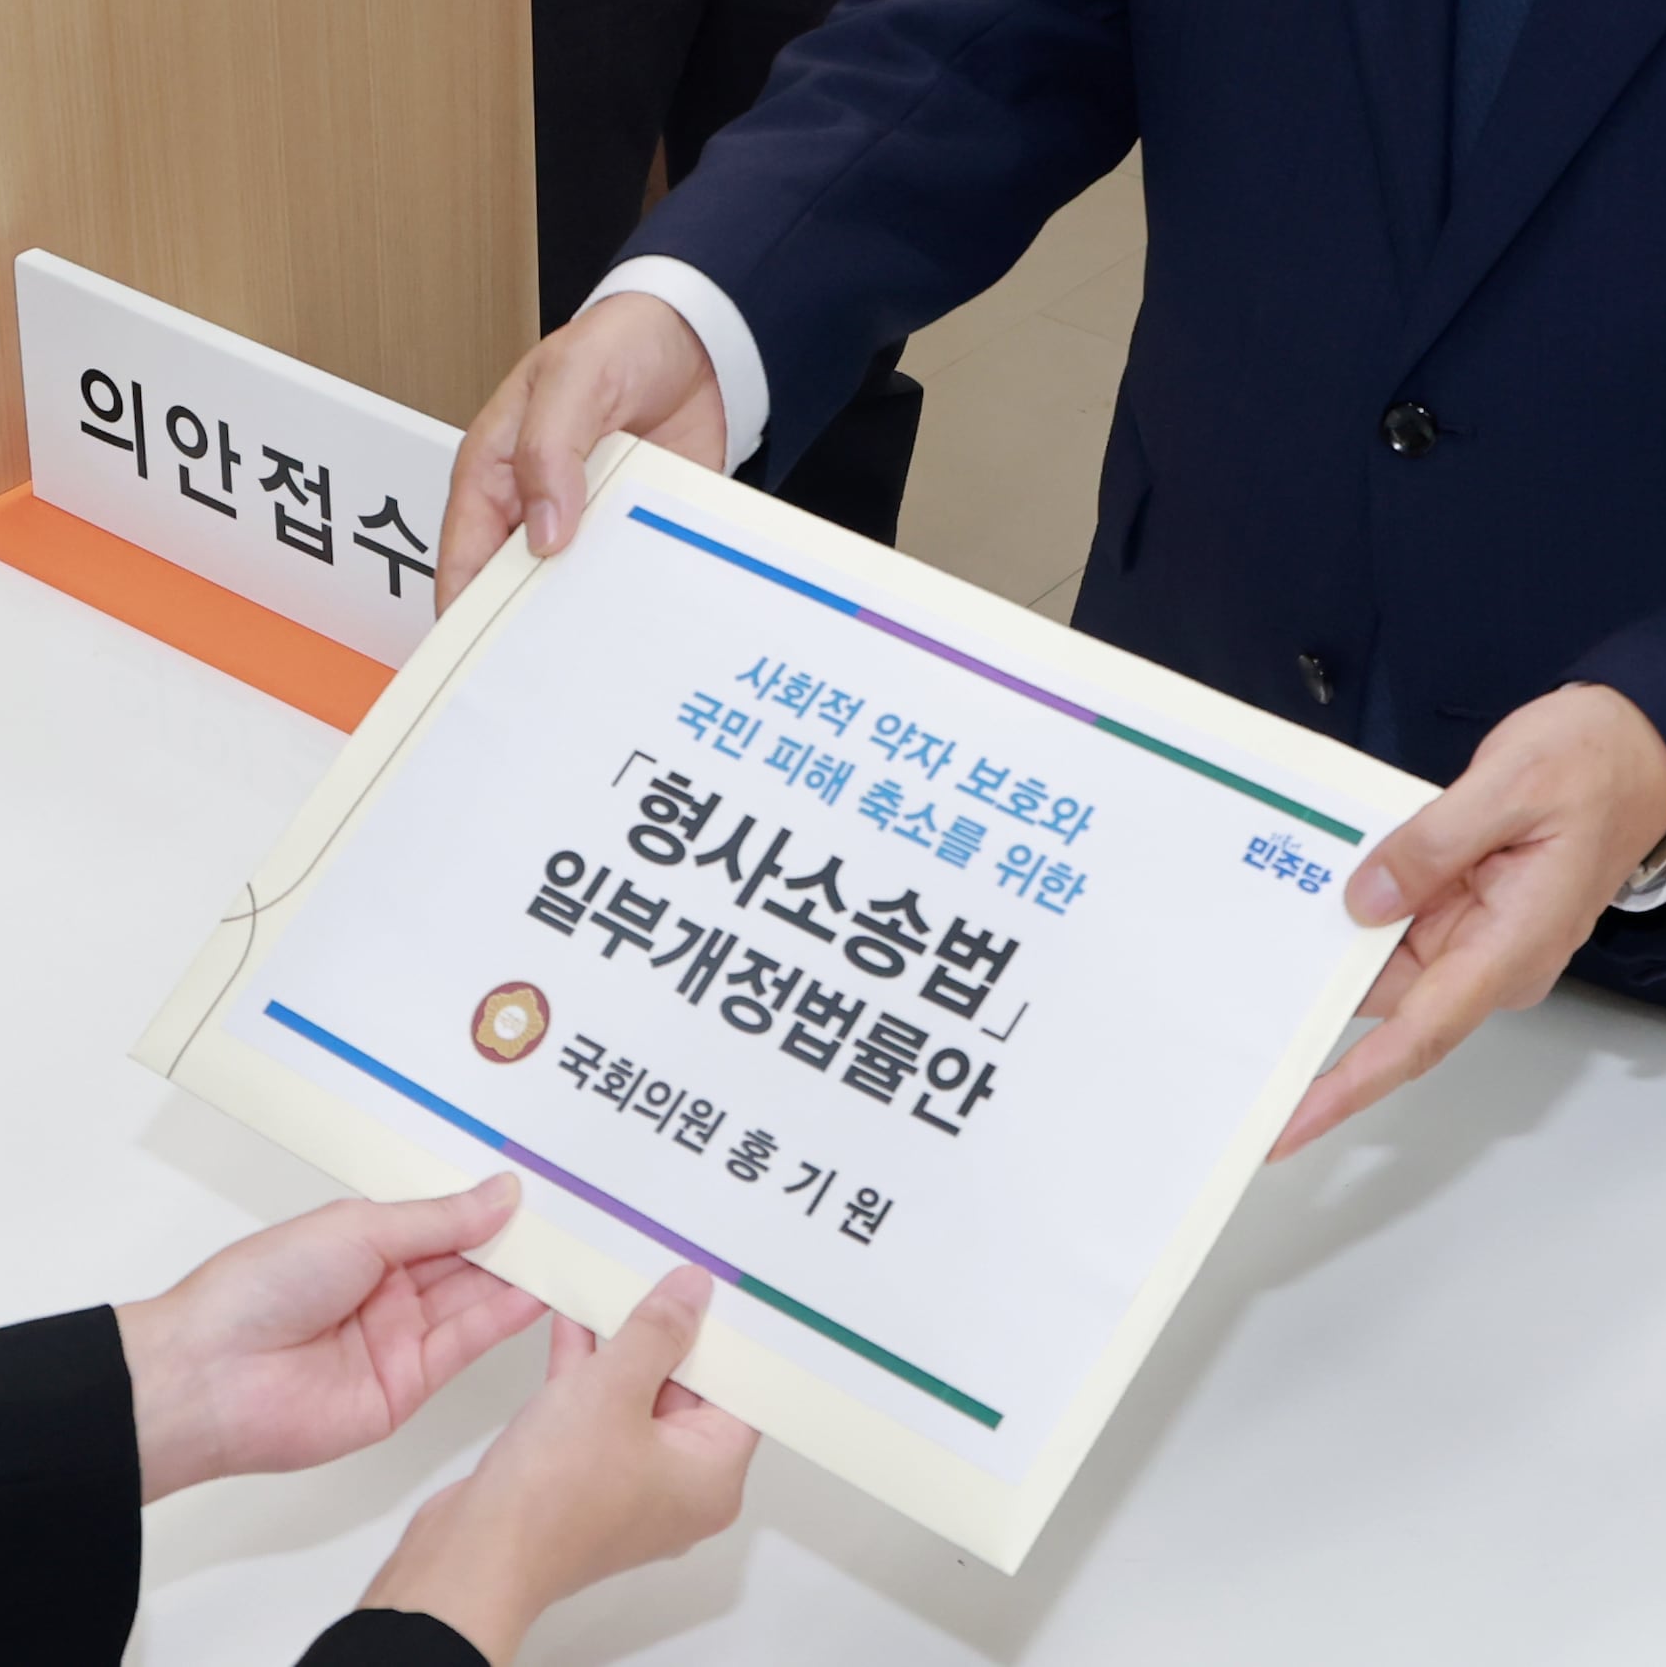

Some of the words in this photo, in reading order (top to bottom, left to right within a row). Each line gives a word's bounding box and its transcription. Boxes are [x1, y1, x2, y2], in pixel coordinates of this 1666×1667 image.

[80, 368, 436, 598] 의안접수
[677, 691, 763, 760] 국민
[764, 734, 856, 806] 피해
[859, 778, 989, 870] 축소를
[995, 844, 1088, 916] 위한
[735, 656, 865, 737] 사회적
[869, 714, 957, 780] 약자
[955, 757, 1095, 846] 보호와
[612, 750, 1029, 1042] 「형사소송법」
[1242, 837, 1332, 894] 민주당
[526, 850, 997, 1137] 일부개정법률안
[558, 1033, 727, 1155] 국회의원
